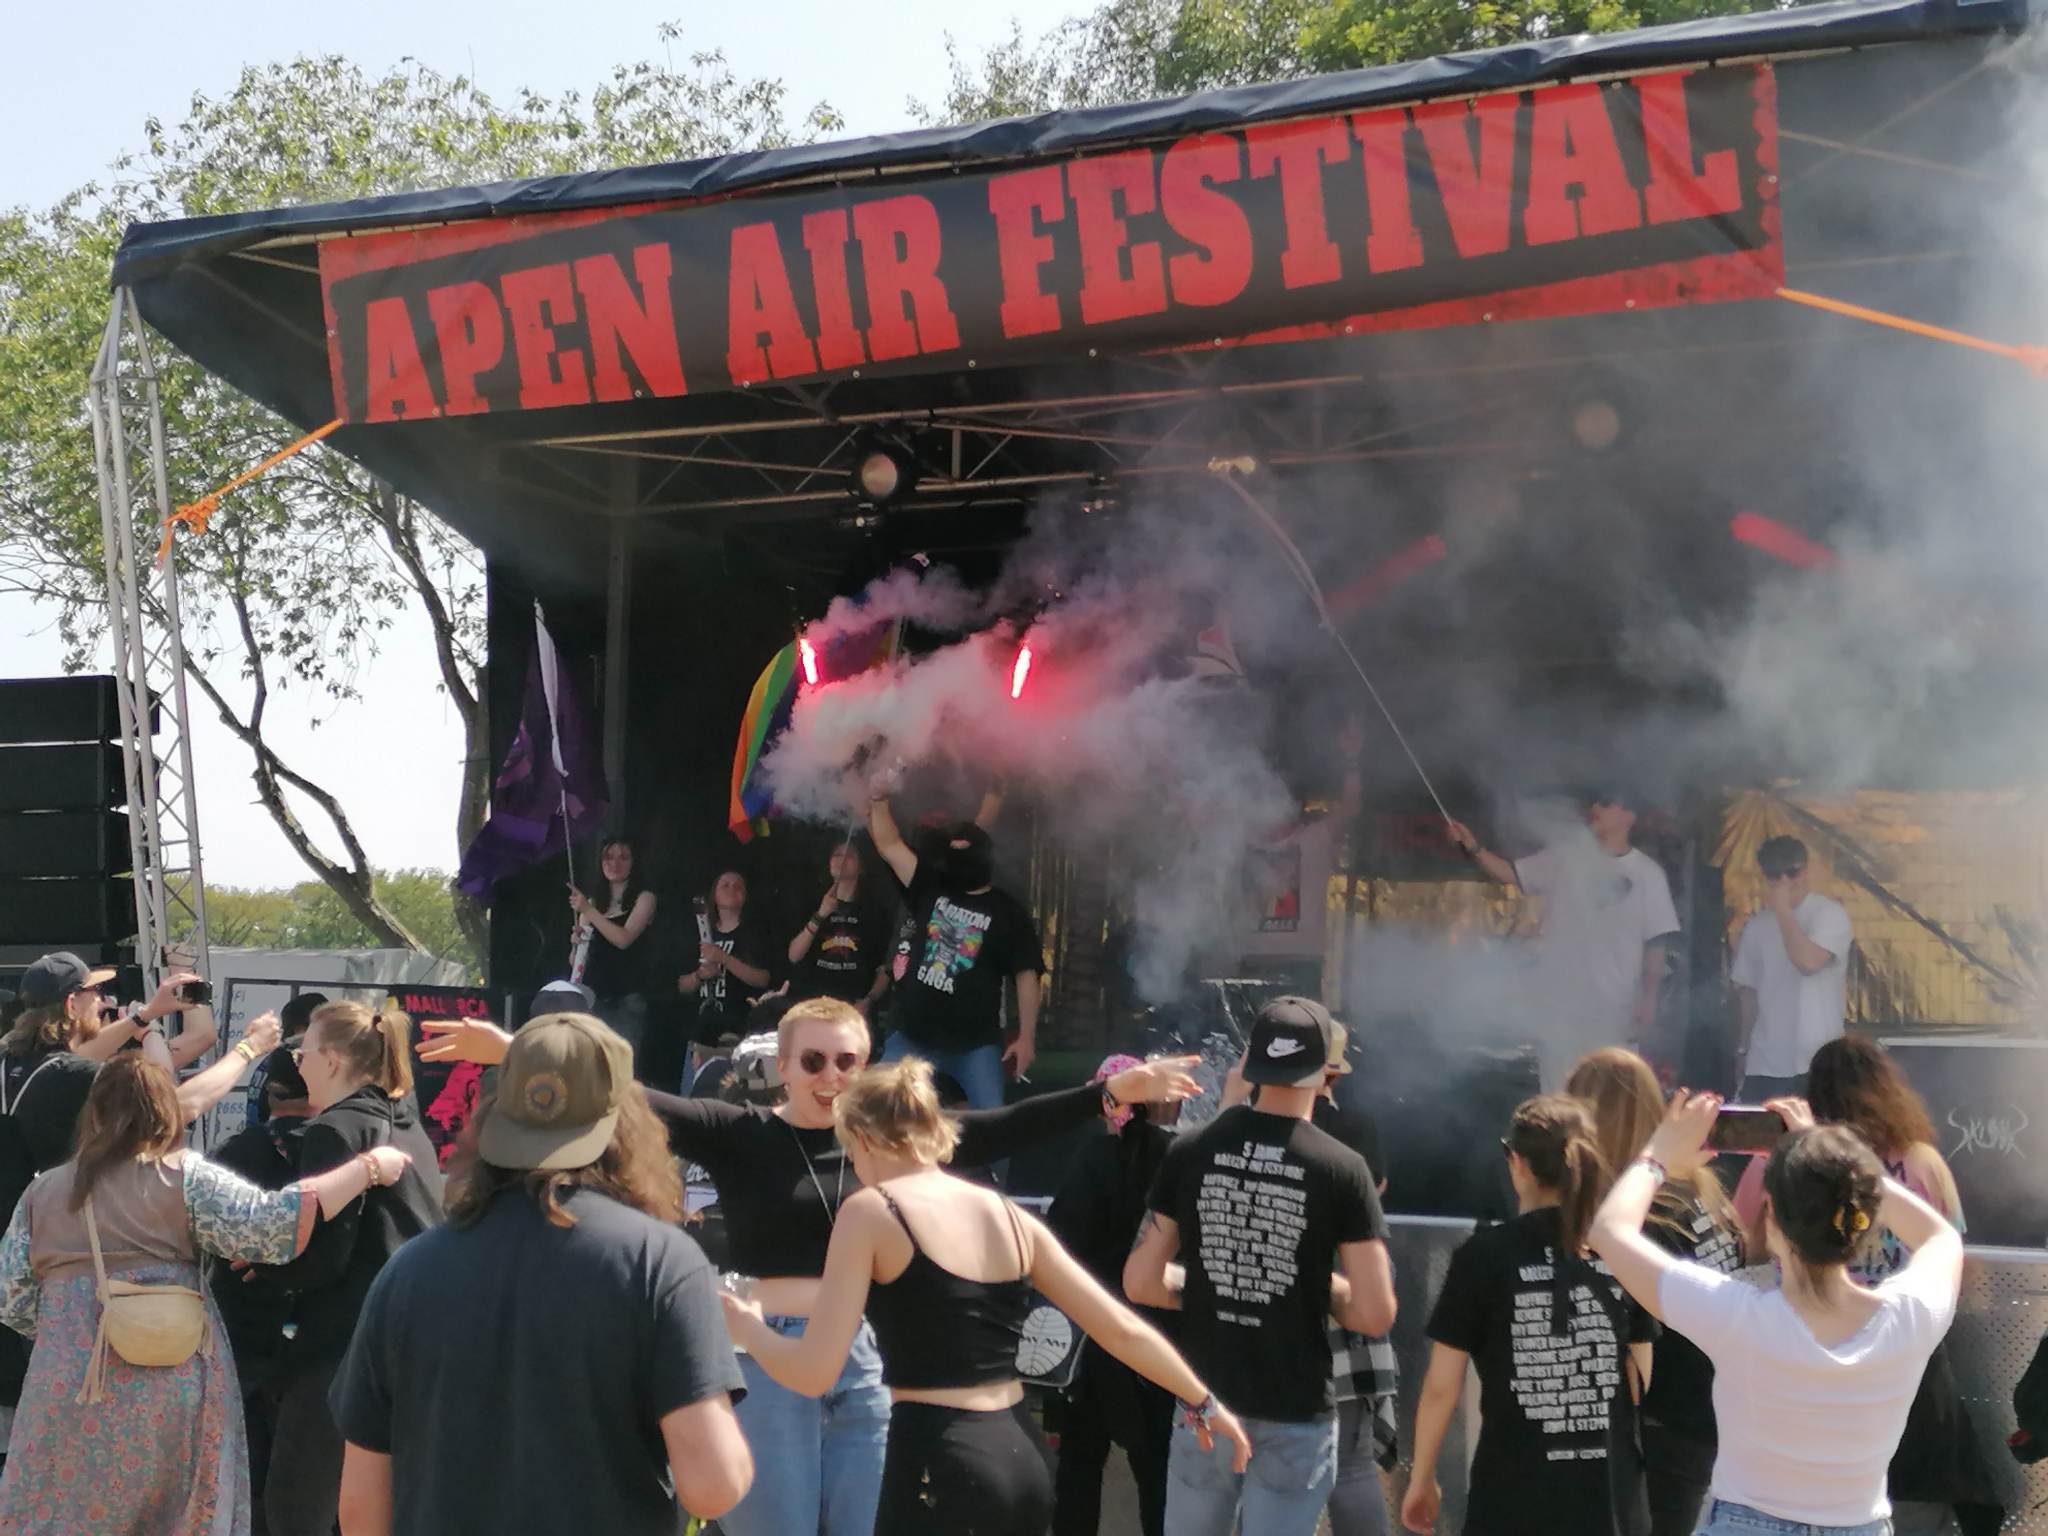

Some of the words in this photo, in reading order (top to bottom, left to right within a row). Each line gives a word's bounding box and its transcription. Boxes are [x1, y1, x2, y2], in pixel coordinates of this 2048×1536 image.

[363, 243, 688, 424] APEN
[727, 195, 961, 387] AIR
[989, 69, 1743, 339] FESTIVAL
